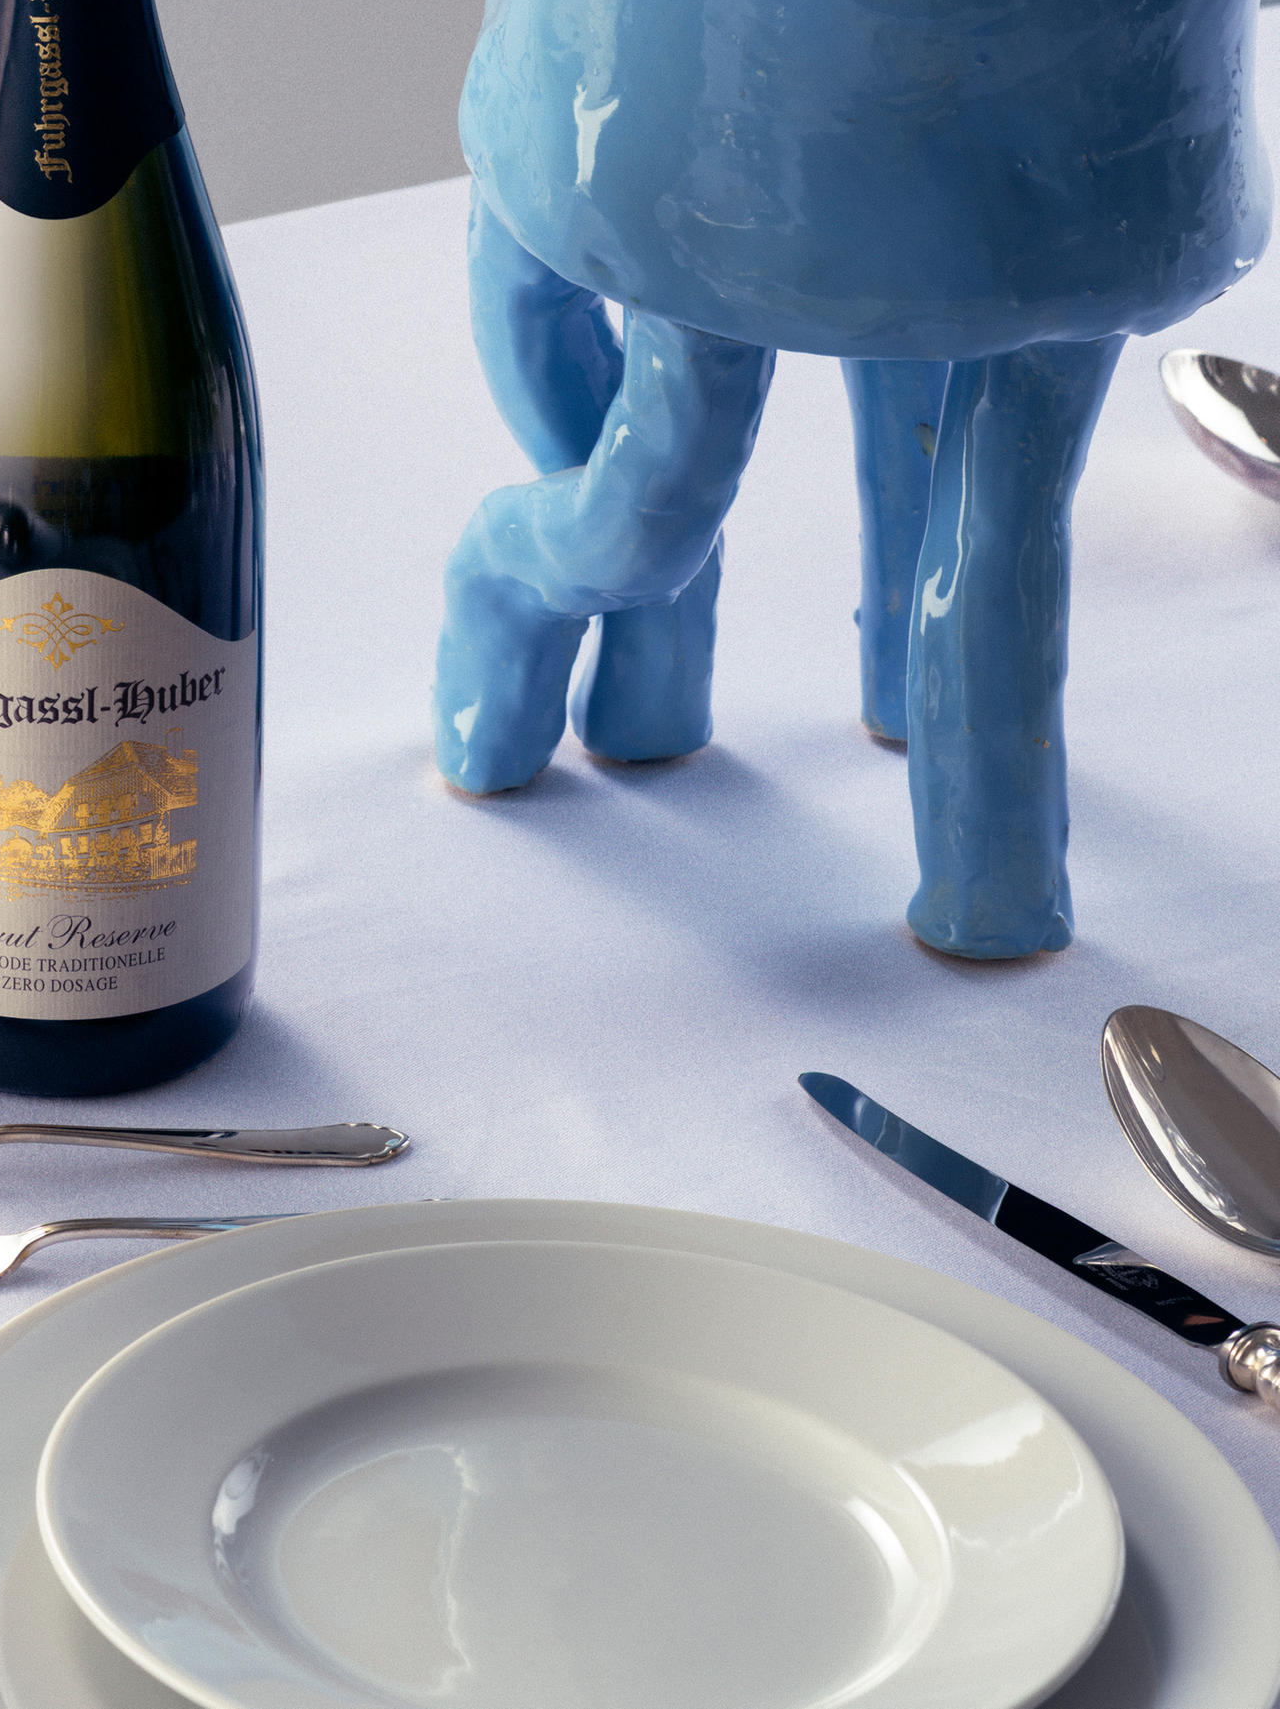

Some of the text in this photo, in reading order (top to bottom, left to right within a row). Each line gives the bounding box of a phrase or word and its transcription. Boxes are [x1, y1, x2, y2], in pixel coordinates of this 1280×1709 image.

[48, 913, 178, 952] Reserve
[37, 947, 166, 974] TRADITIONELLE
[1, 975, 118, 994] ZERO DOSAGE
